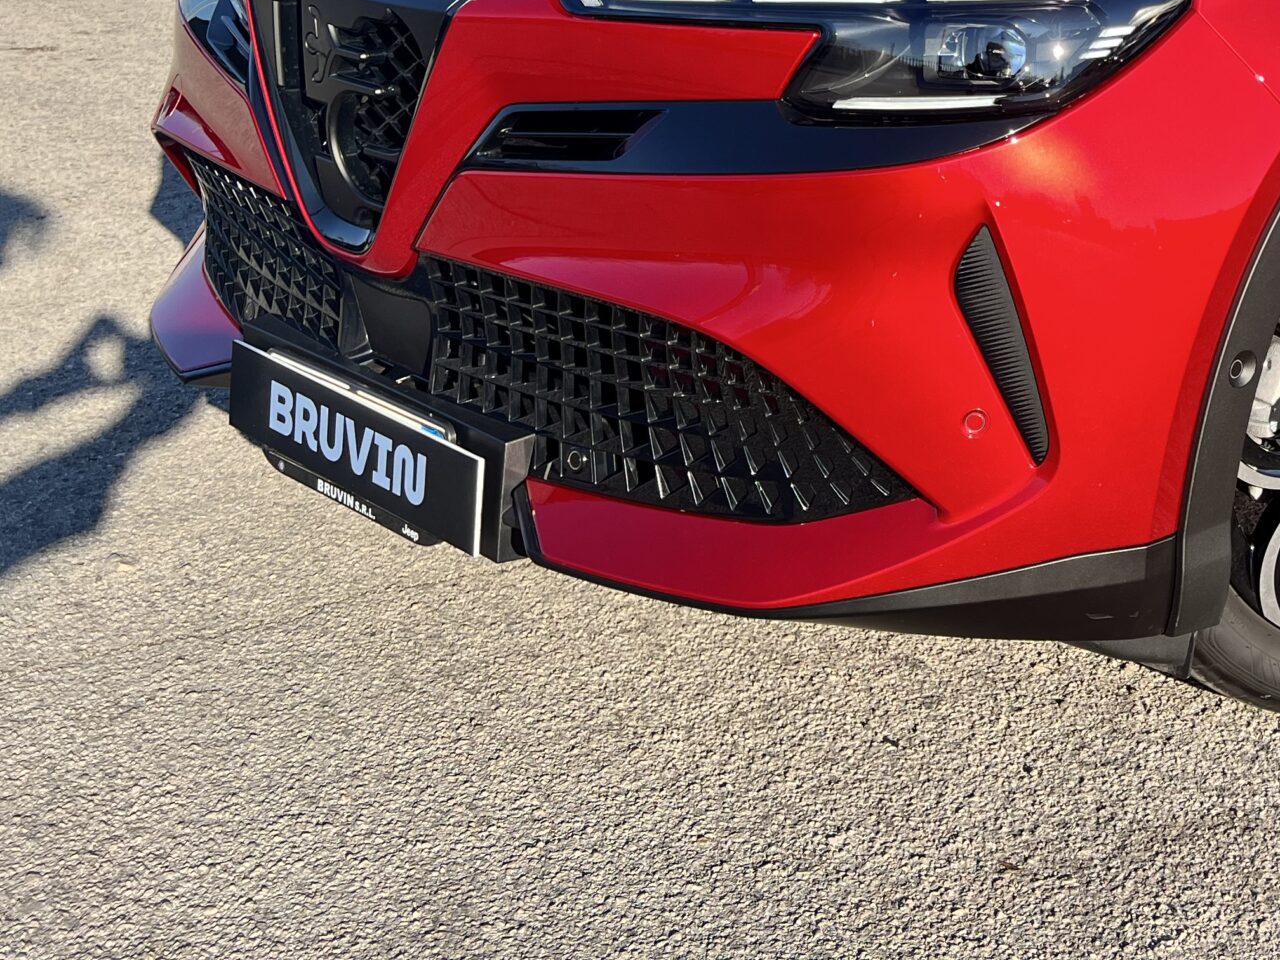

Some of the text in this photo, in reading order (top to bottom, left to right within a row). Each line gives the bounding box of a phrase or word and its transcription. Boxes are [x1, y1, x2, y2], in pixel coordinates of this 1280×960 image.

[268, 380, 427, 506] BRUVIN
[317, 478, 376, 520] BRUVIN S.R.L.
[401, 523, 419, 542] Jeep
